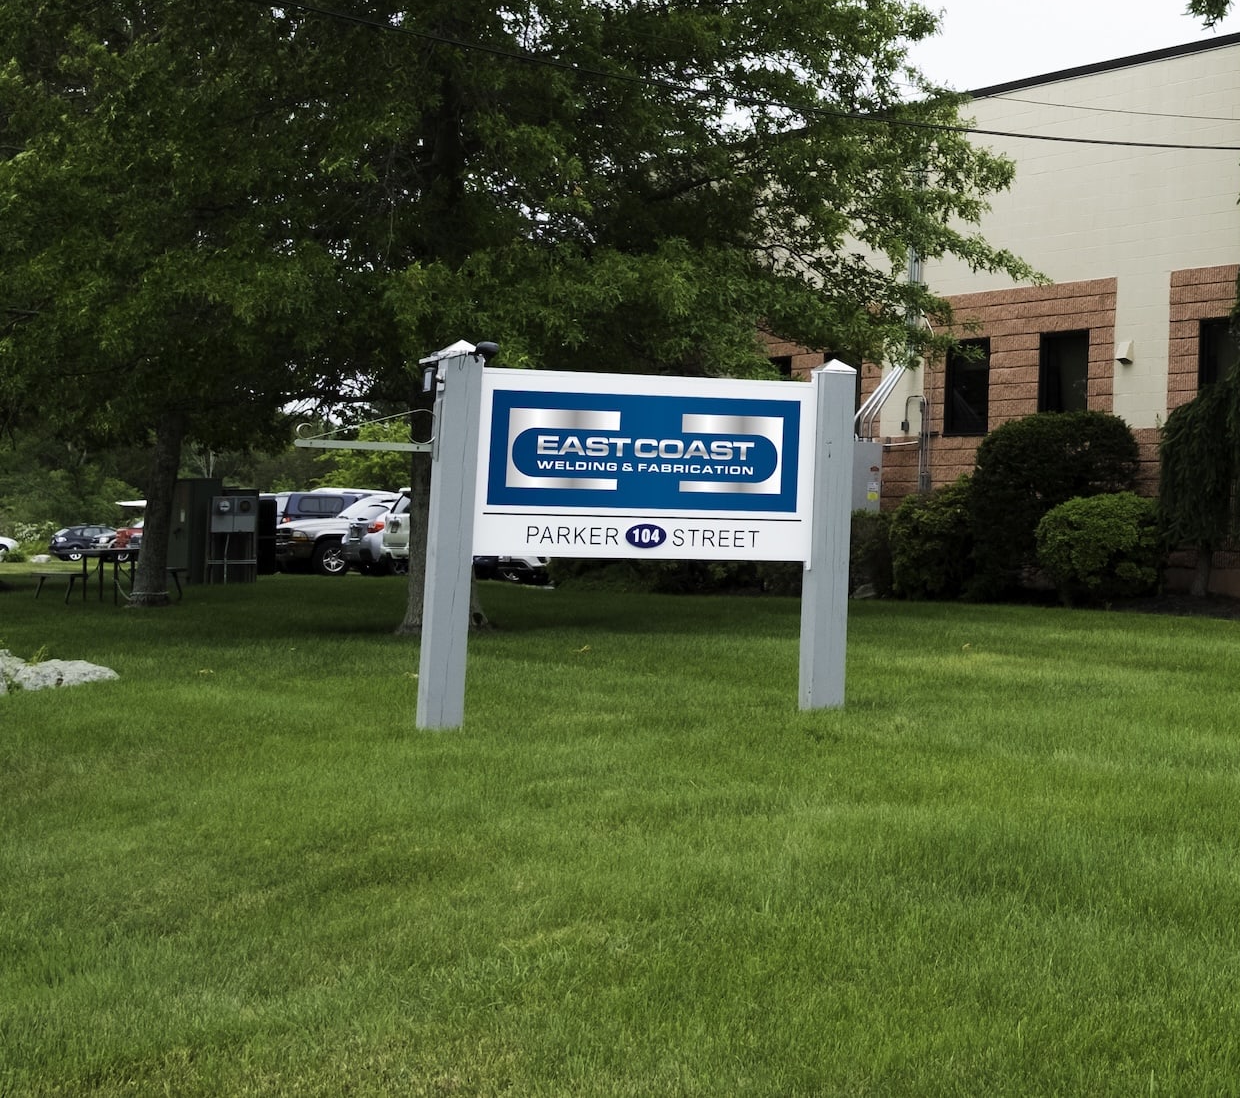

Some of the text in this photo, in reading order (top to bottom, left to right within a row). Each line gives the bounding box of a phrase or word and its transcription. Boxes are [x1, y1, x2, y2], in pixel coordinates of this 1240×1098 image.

[536, 460, 754, 476] WELDING & FABRICATION
[525, 525, 761, 549] PARKER 104 STREET
